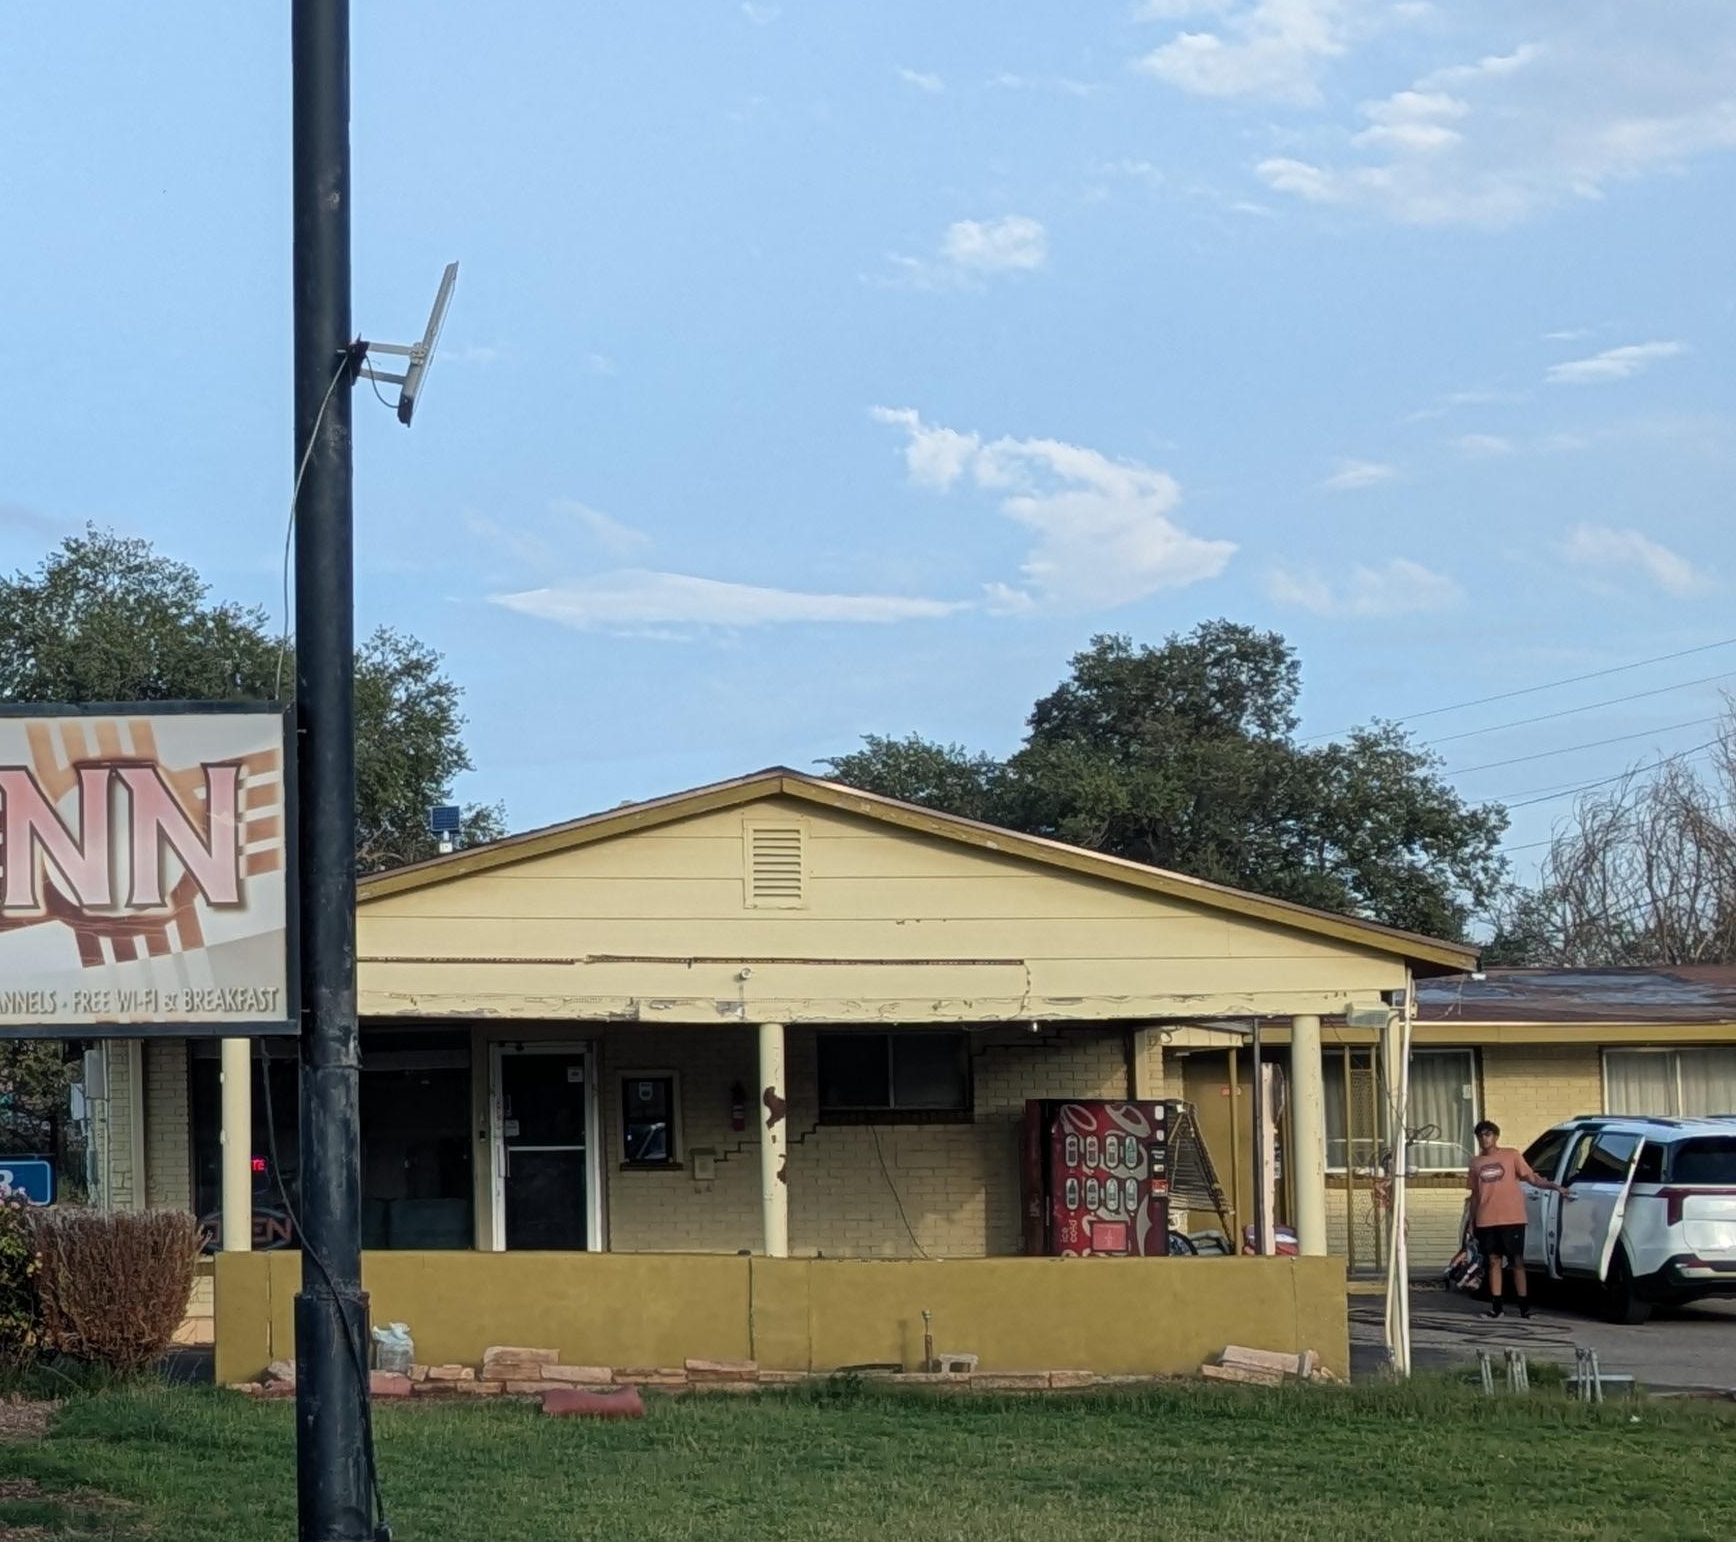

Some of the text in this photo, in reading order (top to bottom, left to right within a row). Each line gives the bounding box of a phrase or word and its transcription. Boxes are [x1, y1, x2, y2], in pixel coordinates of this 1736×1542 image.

[72, 990, 112, 1014] FREE
[115, 989, 159, 1013] WI-FI
[165, 992, 178, 1013] &
[183, 987, 280, 1013] BREAKFAST
